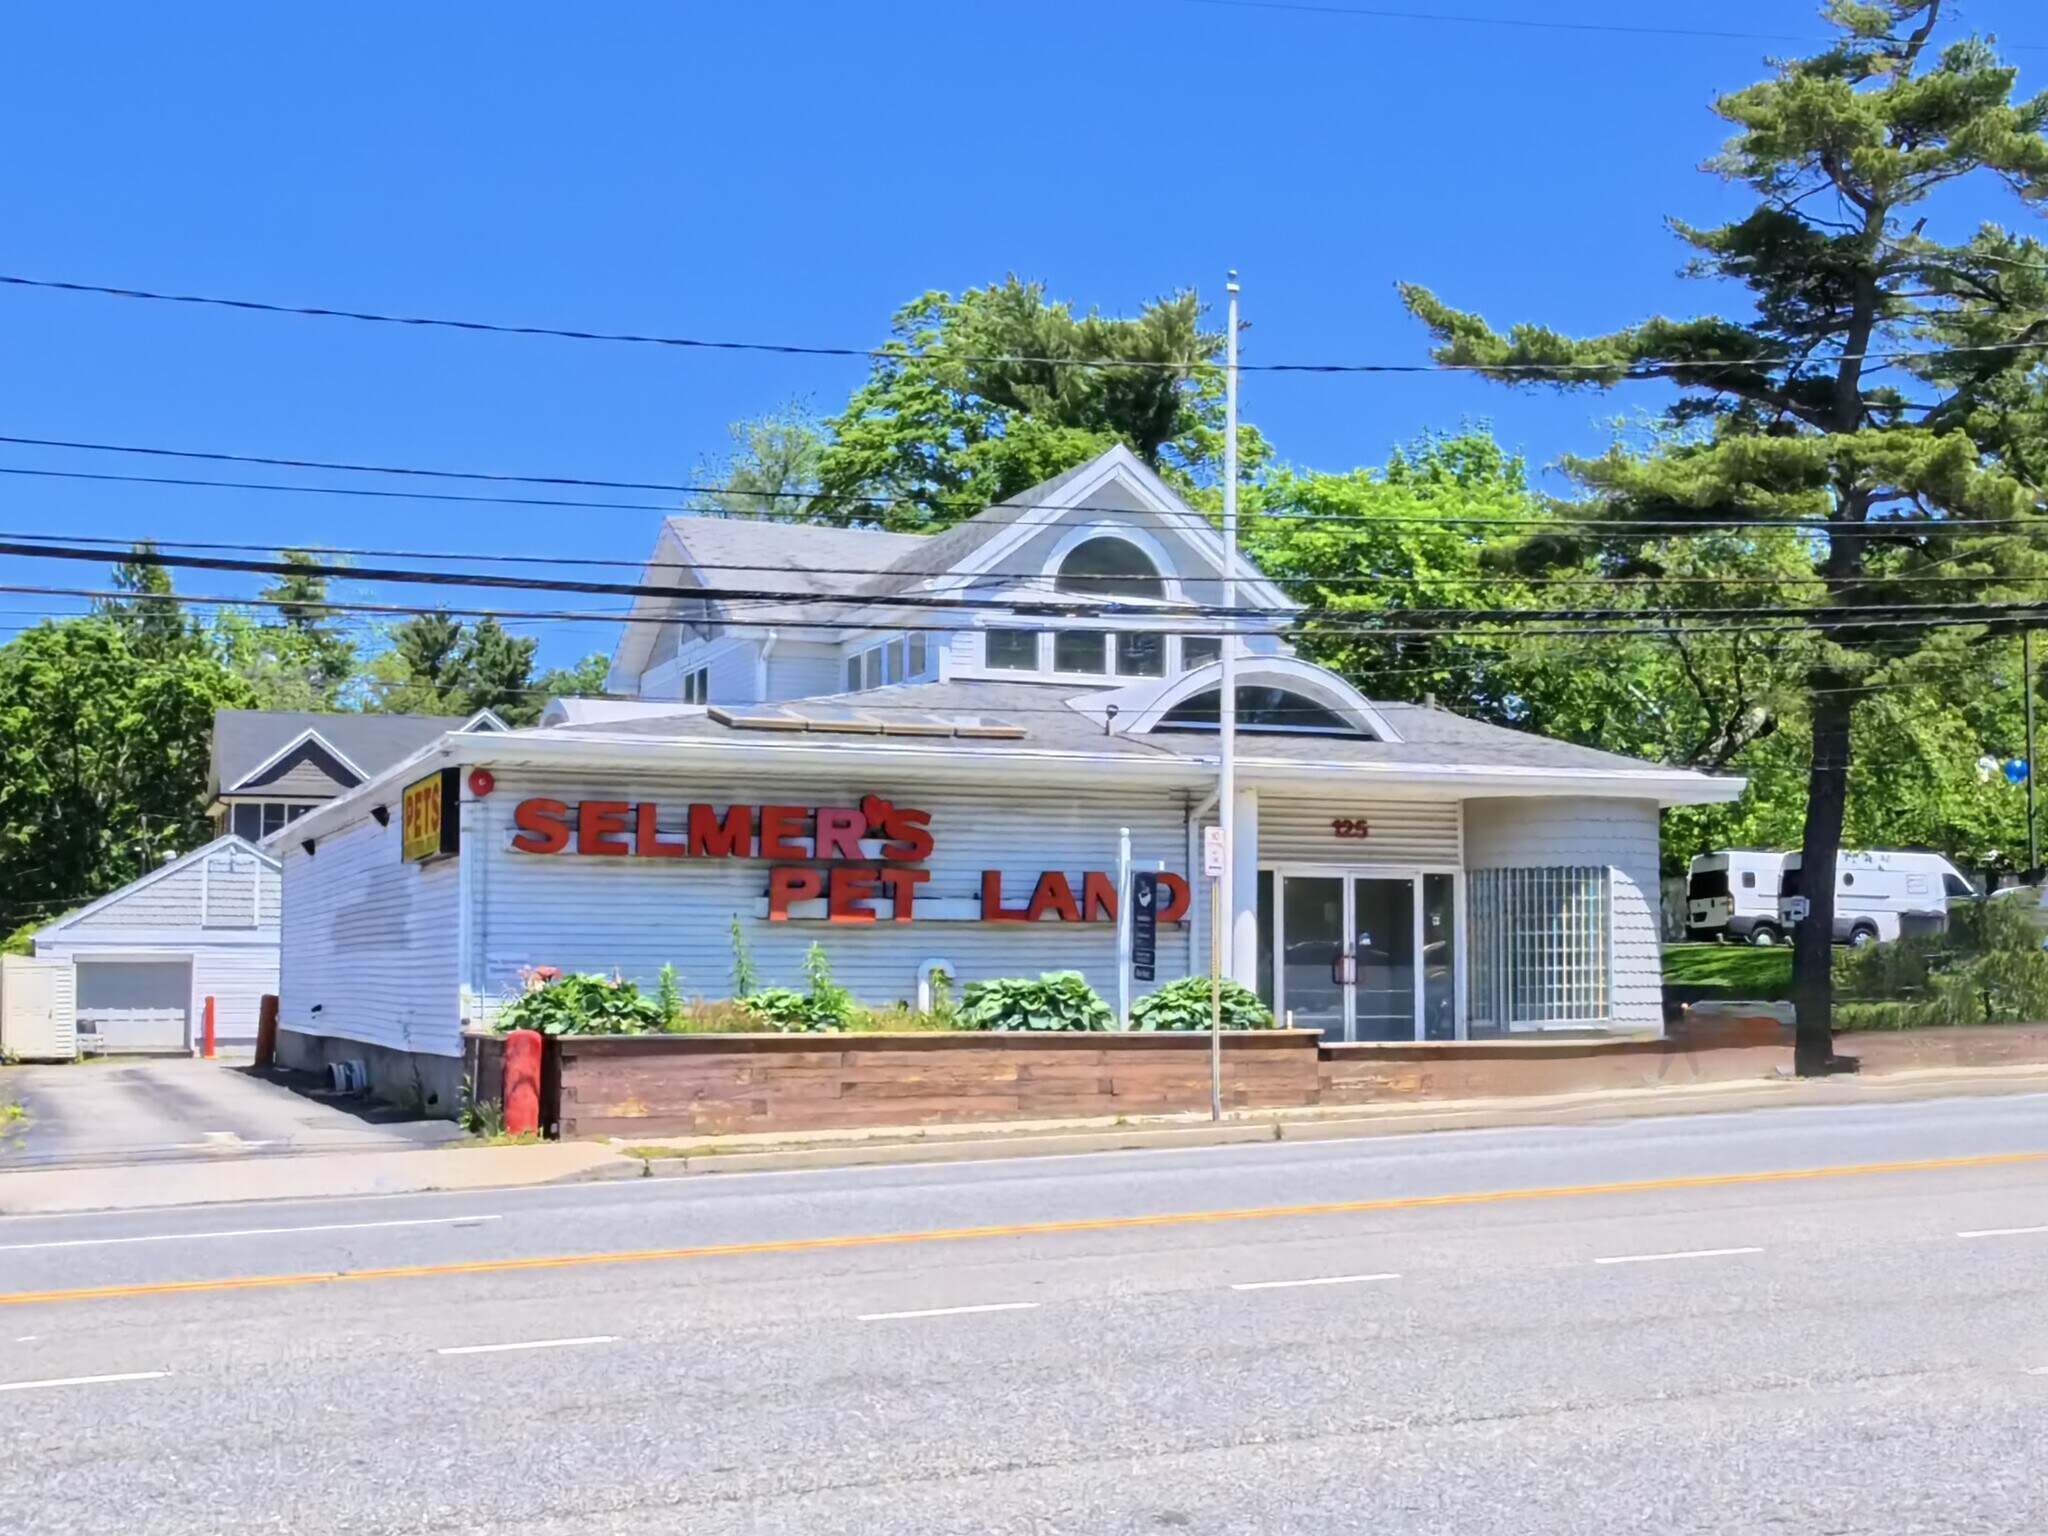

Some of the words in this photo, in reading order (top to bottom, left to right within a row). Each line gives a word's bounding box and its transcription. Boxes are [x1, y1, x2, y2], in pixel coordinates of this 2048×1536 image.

[404, 782, 440, 842] PETS
[1331, 818, 1368, 839] 125
[768, 866, 931, 922] PET
[981, 869, 1191, 923] LAND
